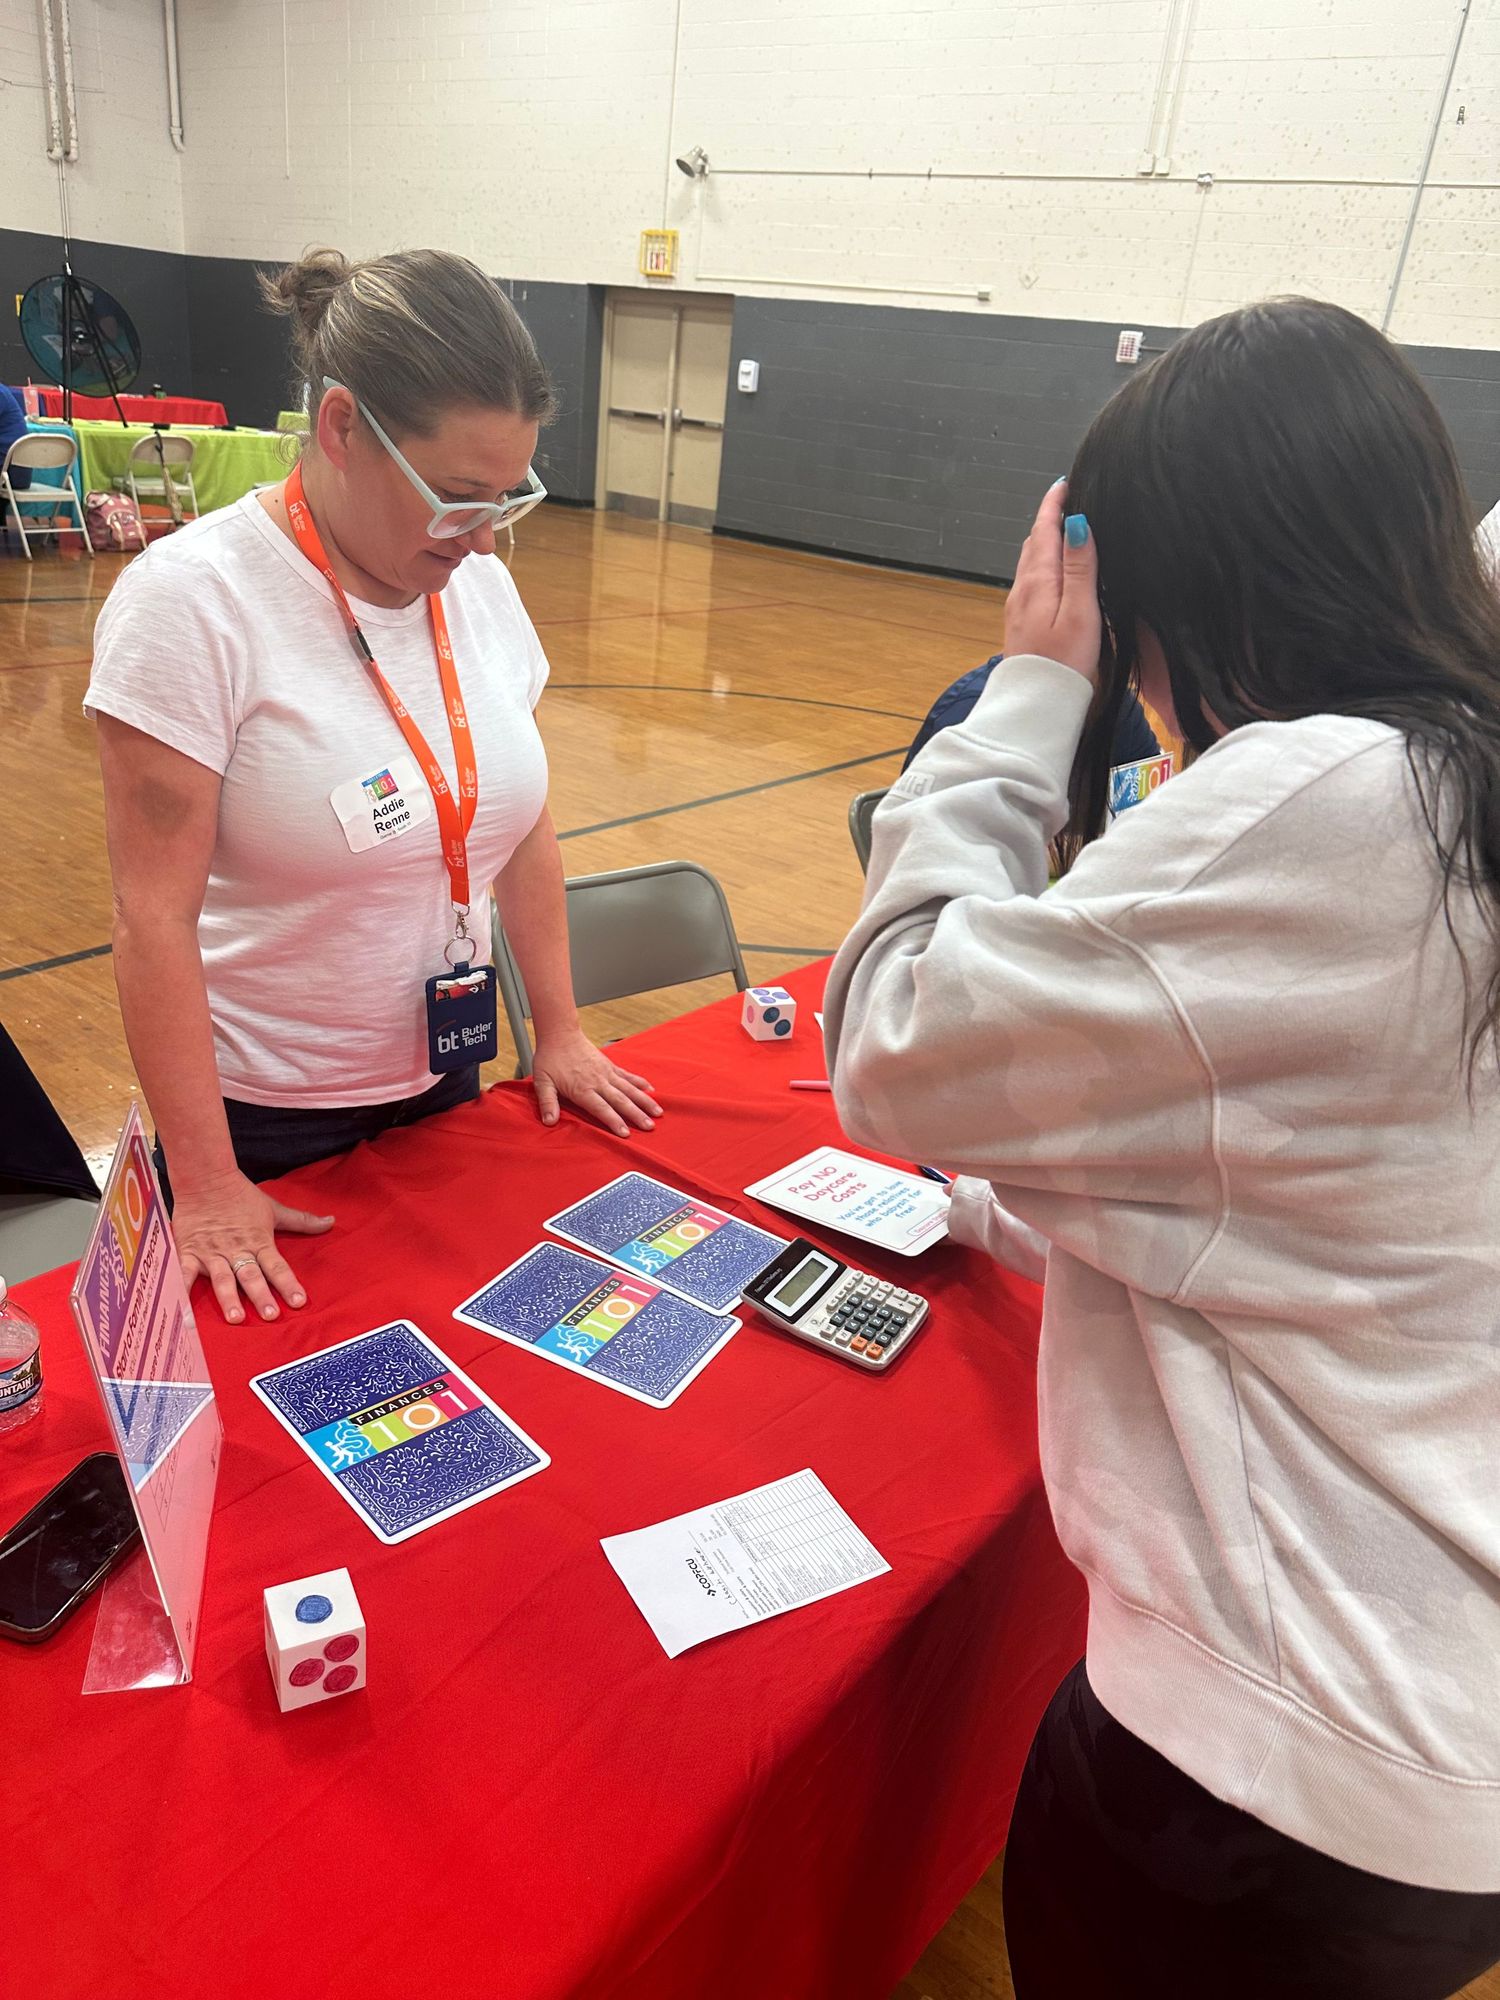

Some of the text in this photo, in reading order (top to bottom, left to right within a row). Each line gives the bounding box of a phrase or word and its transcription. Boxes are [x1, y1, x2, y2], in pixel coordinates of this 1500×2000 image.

[374, 777, 395, 794] 101
[372, 798, 405, 820] Addie
[374, 810, 411, 833] Renne
[437, 1031, 460, 1054] bt
[461, 1021, 492, 1038] Butler
[462, 1033, 487, 1047] Tech
[787, 1166, 837, 1195] Pay NO
[803, 1171, 857, 1201] Daycare
[831, 1181, 867, 1203] Costs
[115, 1139, 151, 1258] 101
[855, 1187, 910, 1222] those relatives
[865, 1215, 882, 1228] who
[908, 1190, 922, 1200] for
[643, 1208, 695, 1243] FINANCES
[657, 1212, 723, 1252] 101
[99, 1240, 111, 1358] FINANCES
[116, 1339, 129, 1379] Start
[128, 1287, 144, 1337] Family
[143, 1219, 160, 1279] Daycare
[567, 1279, 620, 1325] FINANCES
[583, 1284, 652, 1334] 101
[355, 1380, 446, 1425] FINANCES
[371, 1390, 468, 1443] 101
[685, 1557, 711, 1589] COPFCU
